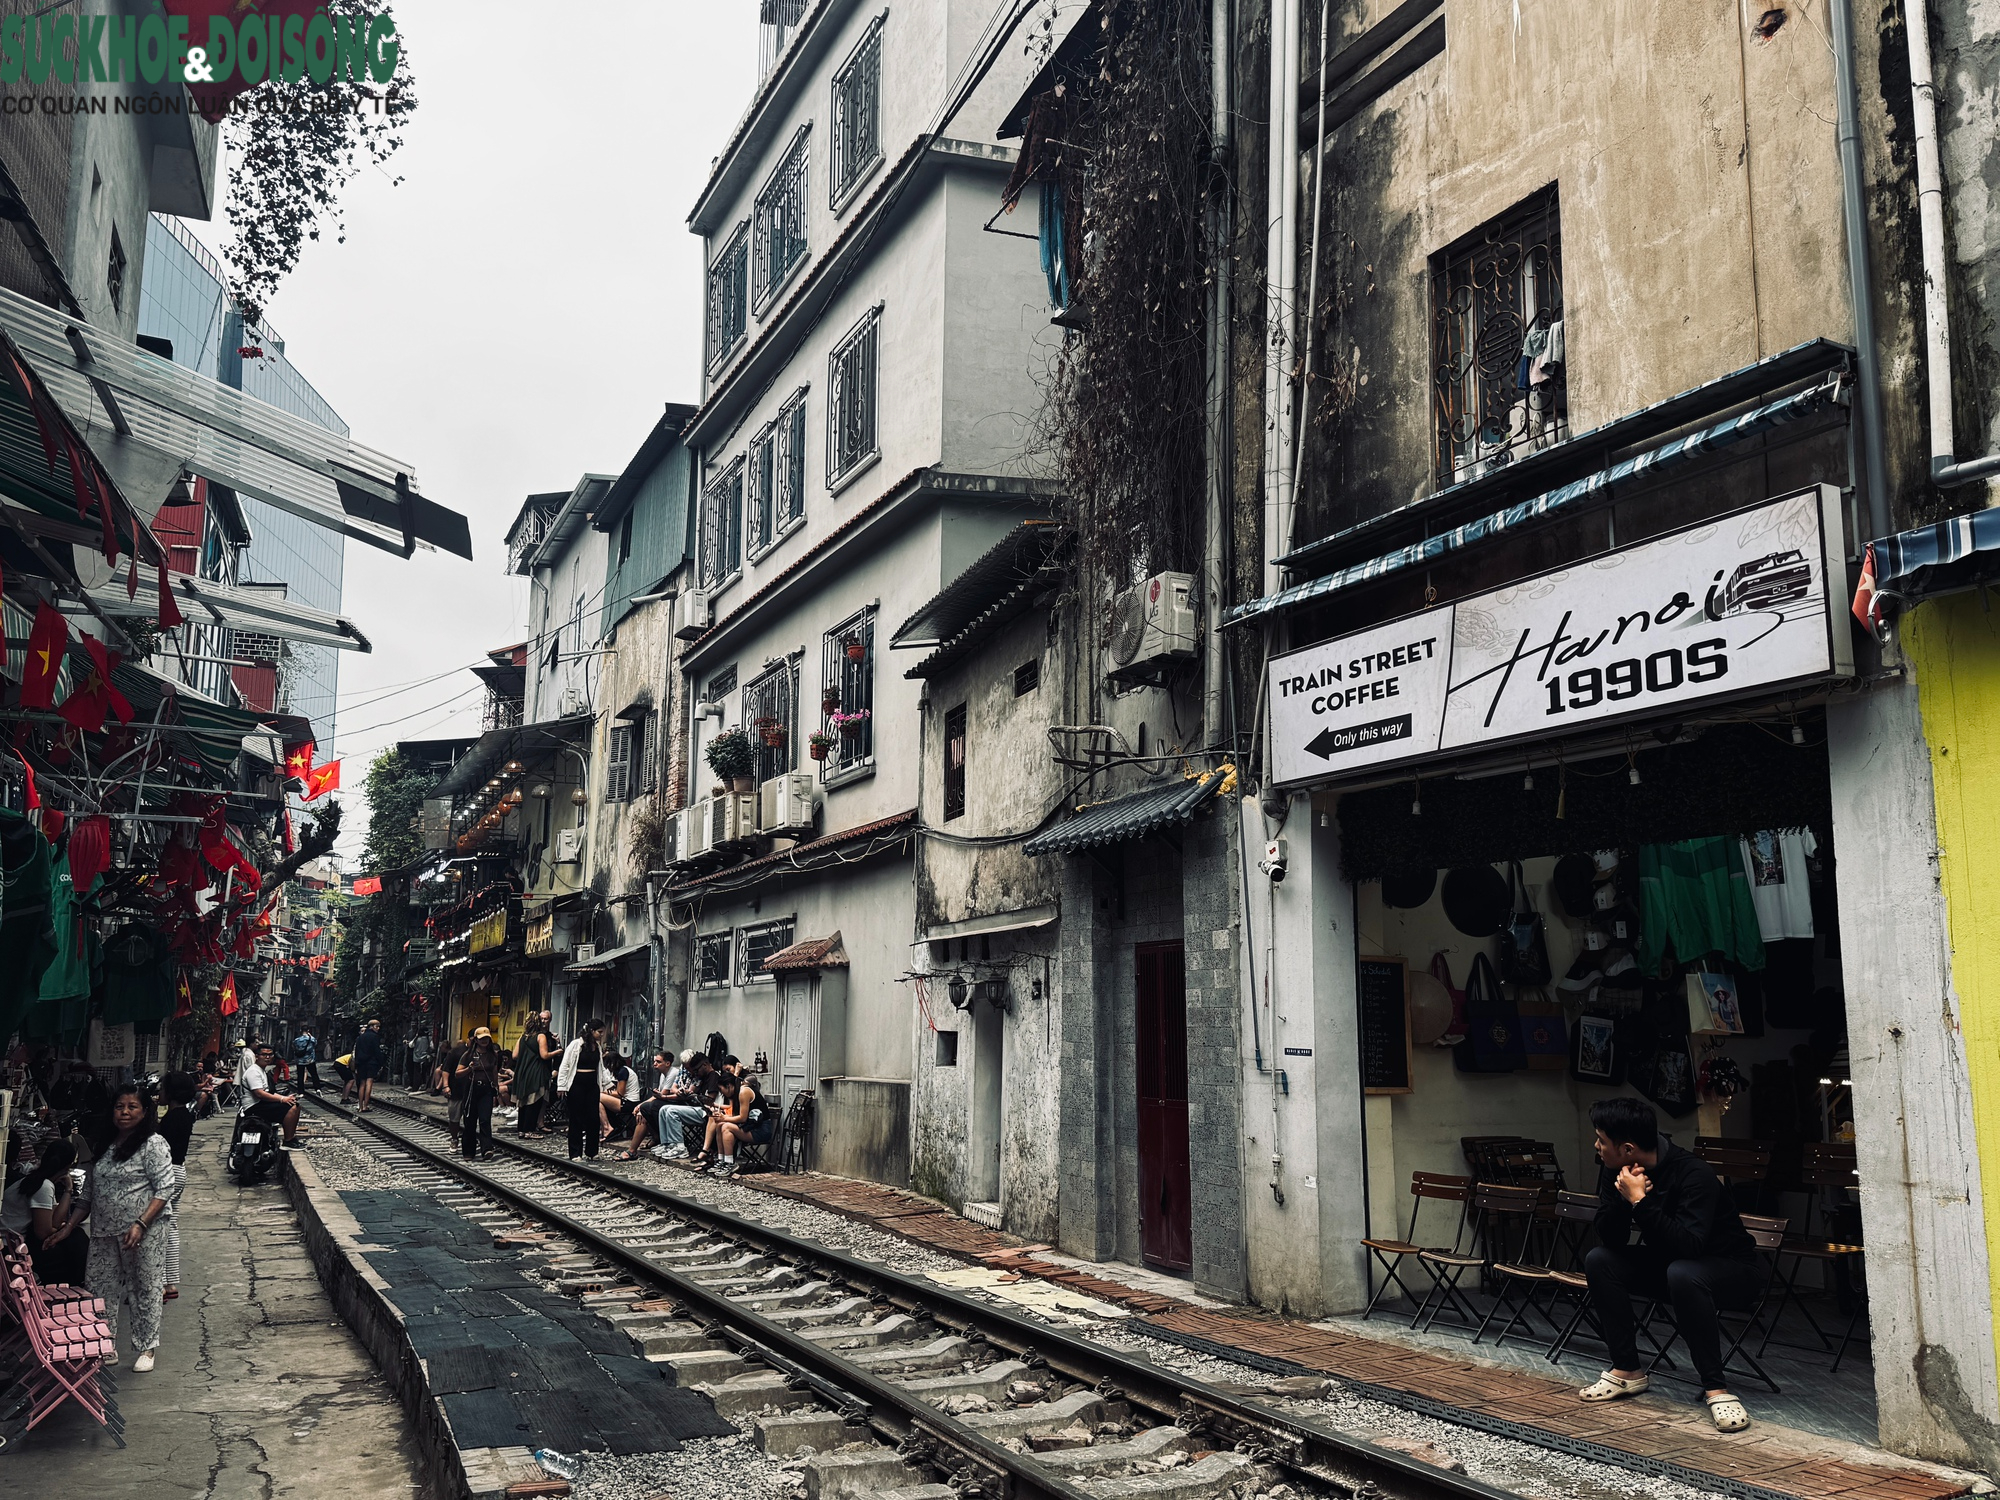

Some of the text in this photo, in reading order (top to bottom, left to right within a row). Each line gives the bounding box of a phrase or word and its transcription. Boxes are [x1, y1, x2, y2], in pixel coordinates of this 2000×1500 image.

[1279, 637, 1437, 698] TRAIN STREET
[1448, 569, 1725, 728] Hanoi
[1544, 637, 1729, 716] 1990S
[1311, 676, 1400, 715] COFFEE
[1334, 721, 1404, 747] Only this way
